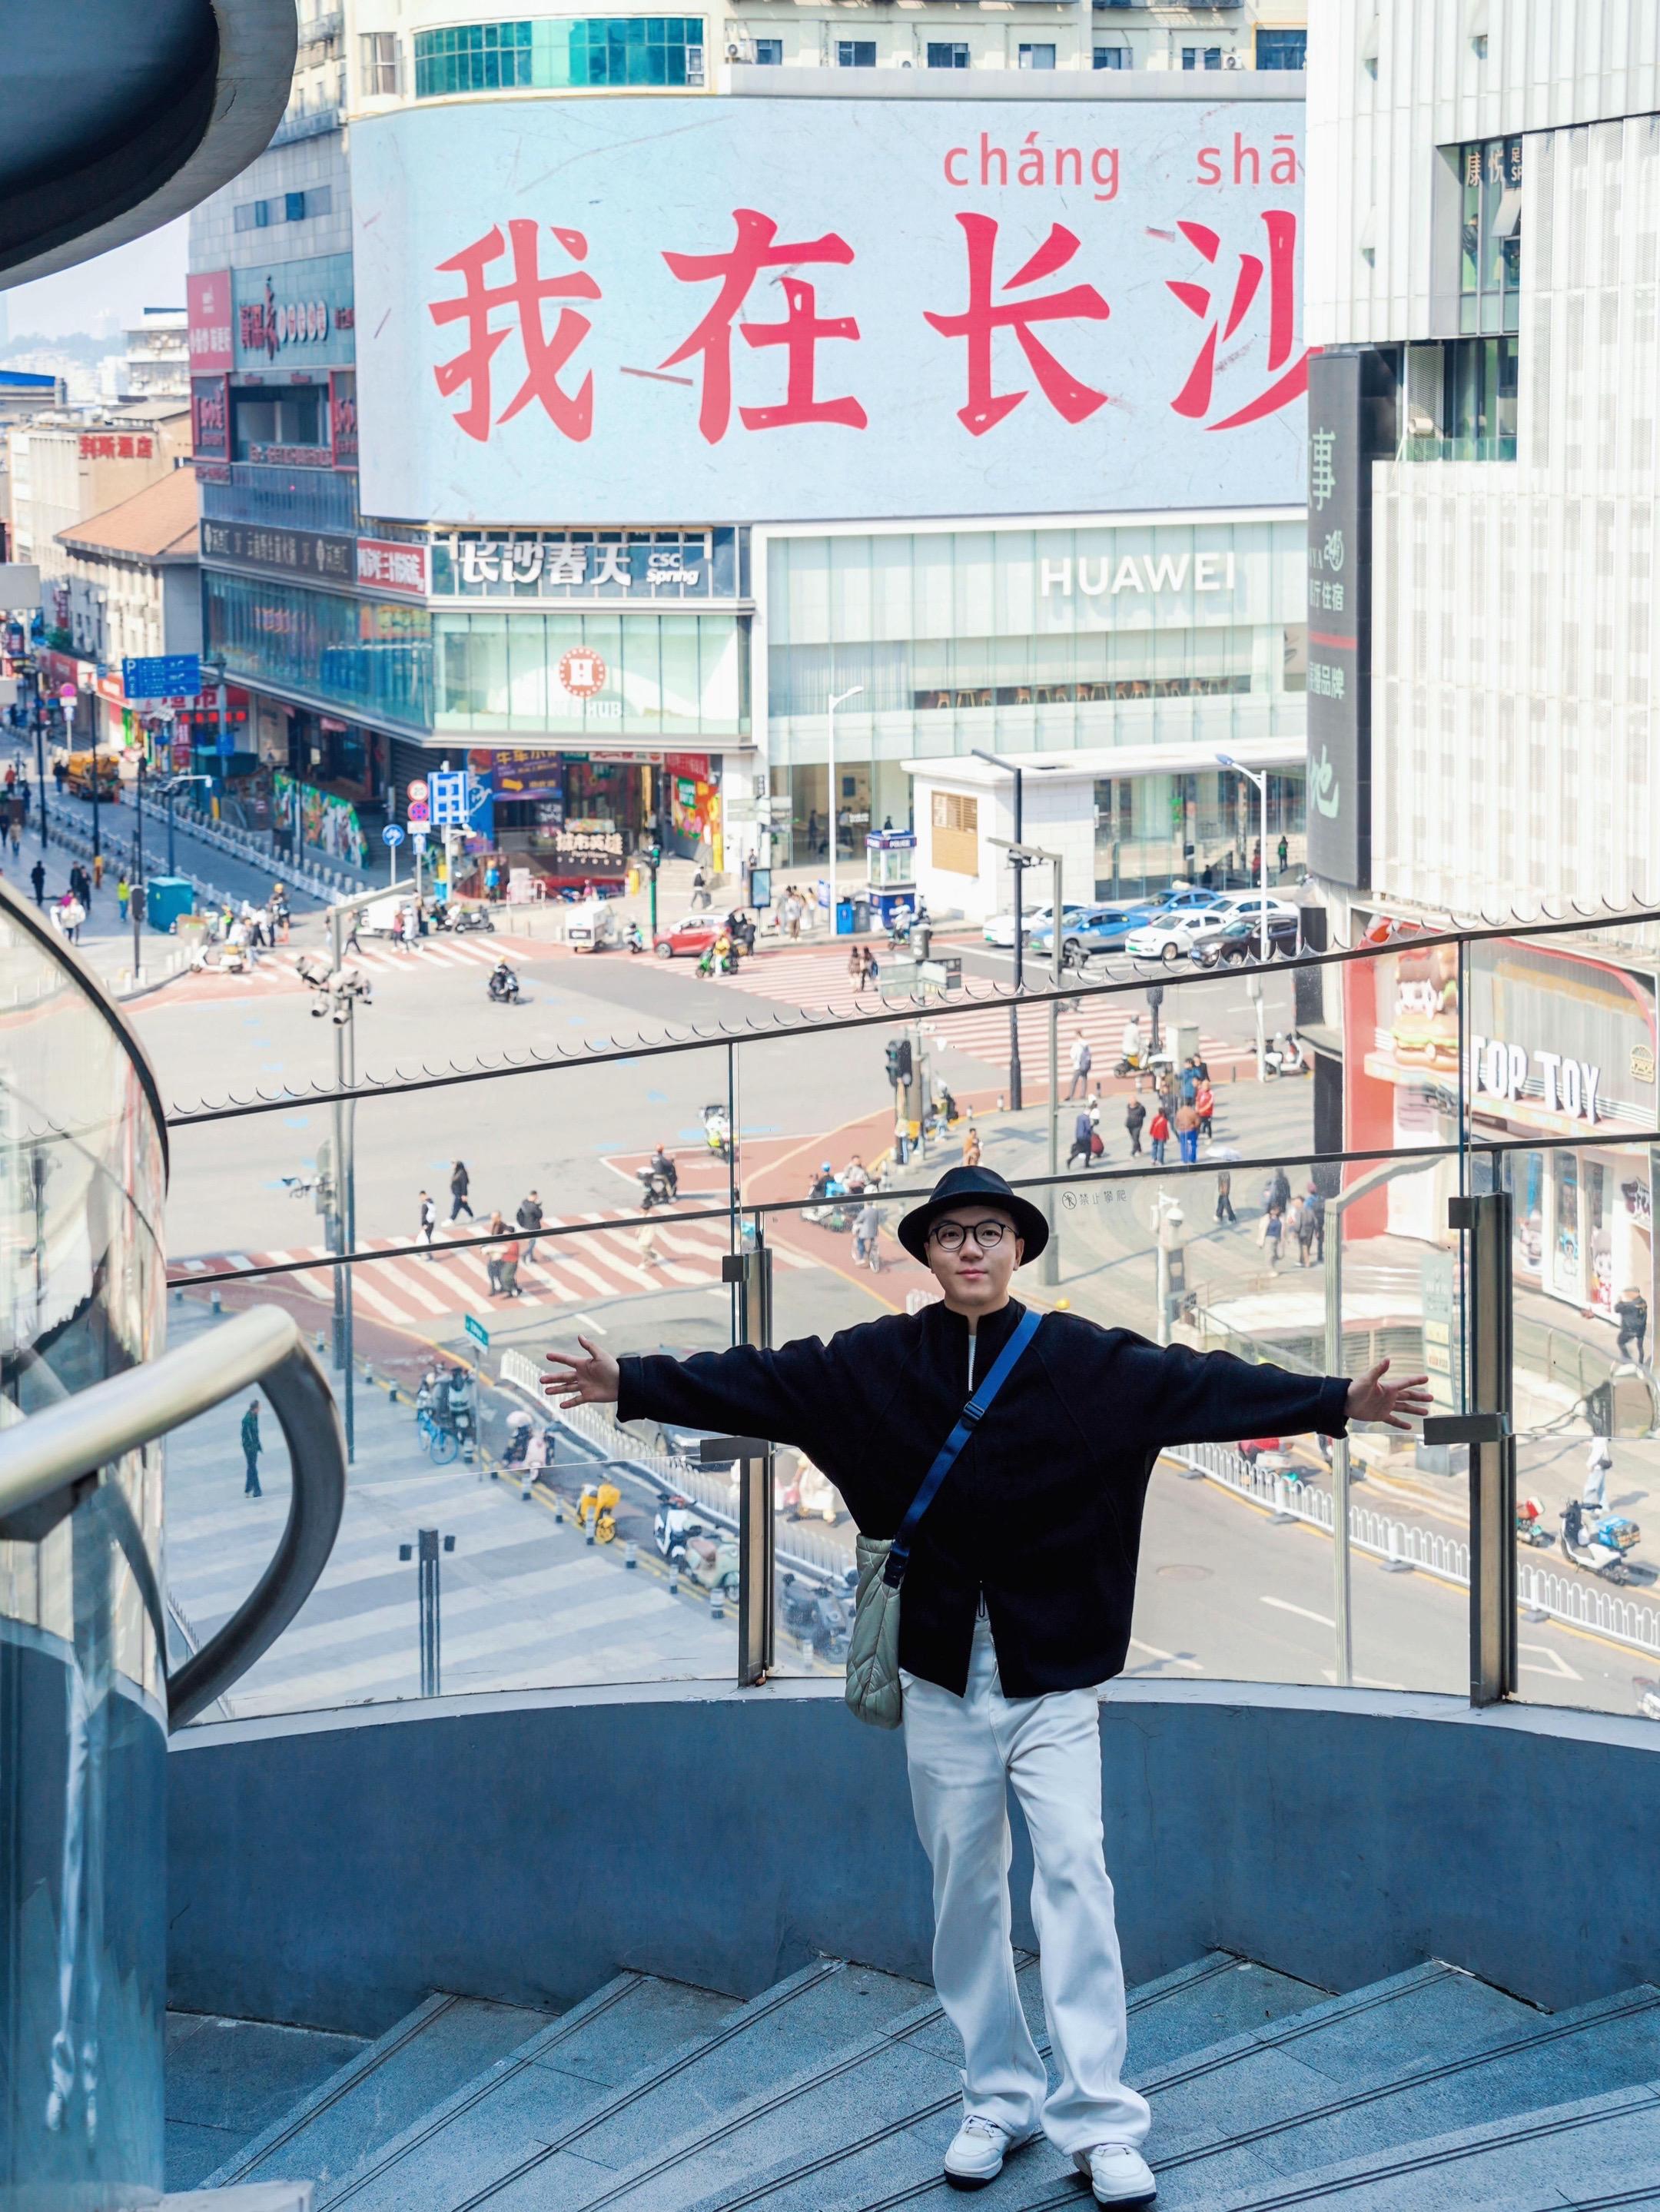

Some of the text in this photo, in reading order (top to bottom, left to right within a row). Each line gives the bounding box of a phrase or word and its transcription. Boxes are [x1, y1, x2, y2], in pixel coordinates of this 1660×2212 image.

[944, 131, 1296, 201] cháng shā
[428, 208, 1324, 445] 我在长沙
[460, 541, 632, 586] 长沙春天
[646, 570, 699, 586] Spring
[648, 553, 682, 567] CSC
[1041, 553, 1235, 596] HUAWEI
[1469, 1035, 1601, 1125] TOP TOY
